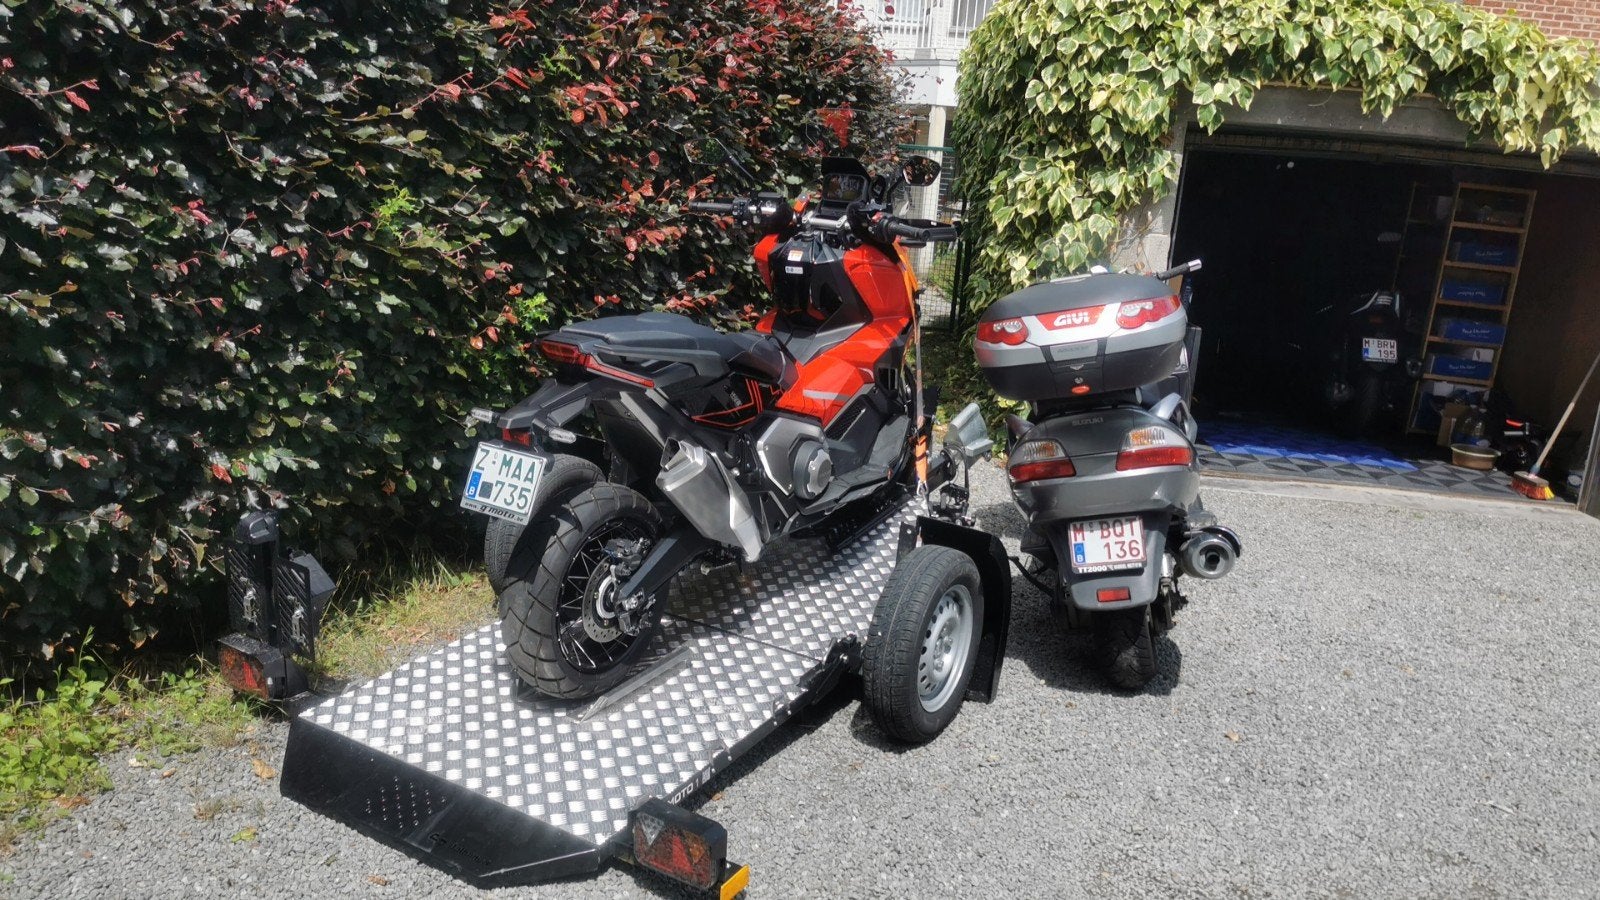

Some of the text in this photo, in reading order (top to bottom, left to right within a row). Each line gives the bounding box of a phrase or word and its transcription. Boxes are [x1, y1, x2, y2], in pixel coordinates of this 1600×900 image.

[1053, 311, 1089, 326] GIVI
[1378, 349, 1396, 359] 195
[1072, 417, 1104, 426] SUZUKI
[493, 479, 531, 510] 735
[1103, 539, 1140, 560] 136
